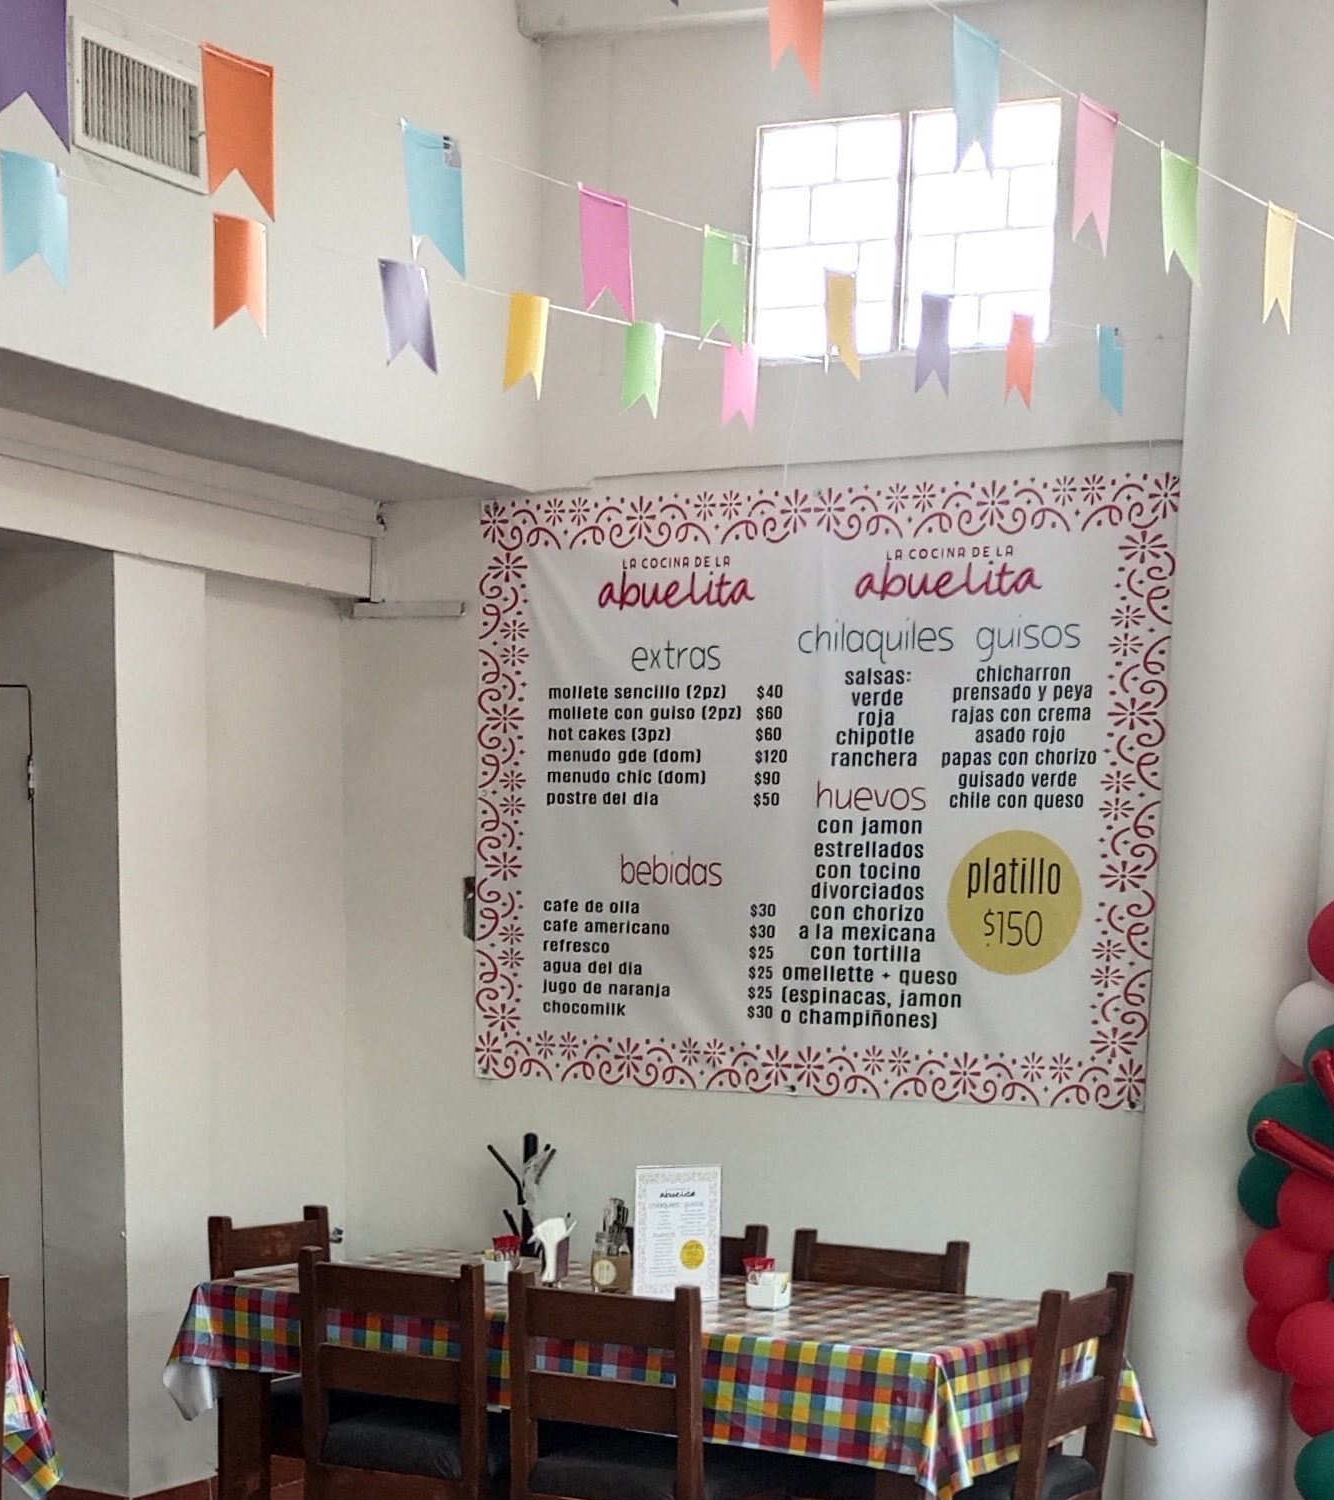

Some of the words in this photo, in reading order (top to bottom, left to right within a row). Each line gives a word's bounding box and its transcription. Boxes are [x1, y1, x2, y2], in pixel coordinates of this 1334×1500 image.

[886, 549, 902, 561] LA
[909, 547, 966, 560] COCINA
[972, 546, 991, 558] DE
[996, 545, 1014, 557] LA
[622, 558, 636, 570] LA
[641, 557, 690, 569] COCINA
[695, 556, 711, 568] DE
[716, 556, 730, 567] LA
[854, 559, 1043, 601] abuelita
[598, 571, 755, 611] abuelita
[798, 617, 954, 664] chilaquiles
[976, 614, 1081, 663] guisos
[632, 640, 721, 672] extras
[844, 668, 912, 686] salsas:
[976, 665, 1071, 682] chicharron
[548, 685, 608, 699] mollete
[614, 685, 680, 699] sencillo
[686, 684, 727, 701] (2pz)
[756, 684, 783, 701] $40
[851, 689, 903, 707] verde
[953, 684, 1031, 703] prensado
[1038, 685, 1047, 702] y
[1053, 684, 1093, 702] peya
[548, 706, 608, 720] mollete
[614, 707, 643, 720] con
[650, 706, 695, 722] guiso
[701, 706, 742, 722] (2pz)
[756, 705, 783, 722] $60
[857, 708, 895, 728] roja
[951, 707, 994, 724] rajas
[1000, 705, 1031, 722] con
[1038, 705, 1091, 722] crema
[548, 728, 573, 741] hot
[578, 728, 626, 741] cakes
[631, 727, 671, 743] (3pz)
[755, 727, 782, 743] $60
[835, 727, 915, 748] chipotle
[975, 727, 1025, 744] asado
[1032, 726, 1065, 745] rojo
[547, 749, 611, 762] menudo
[617, 749, 647, 764] gde
[653, 748, 701, 764] (dom)
[754, 749, 788, 765] $120
[830, 749, 917, 767] ranchera
[941, 750, 992, 768] papas
[998, 750, 1028, 766] con
[1035, 748, 1097, 766] chorizo
[547, 770, 610, 784] menudo
[617, 770, 652, 784] chic
[657, 770, 706, 786] (dom)
[754, 771, 781, 787] $90
[958, 770, 1025, 789] guisado
[1031, 770, 1077, 788] verde
[546, 792, 597, 807] postre
[602, 792, 626, 806] del
[753, 792, 780, 808] $50
[816, 780, 926, 812] huevos
[949, 792, 991, 809] chile
[997, 792, 1027, 809] con
[1034, 792, 1084, 810] queso
[817, 818, 853, 835] con
[861, 817, 923, 836] jamon
[814, 841, 924, 859] estrellados
[621, 852, 723, 887] bebidas
[815, 863, 852, 880] con
[859, 861, 921, 880] tocino
[967, 857, 1061, 899] platillo
[811, 881, 924, 901] divorciados
[543, 899, 579, 913] cafe
[584, 899, 604, 914] de
[609, 900, 640, 914] olla
[750, 903, 776, 918] $30
[810, 905, 845, 922] con
[853, 904, 924, 923] chorizo
[543, 919, 578, 933] cafe
[584, 920, 670, 935] americano
[749, 924, 776, 939] $30
[799, 925, 809, 941] a
[815, 924, 833, 941] la
[841, 924, 936, 943] mexicana
[984, 908, 1043, 947] $150
[543, 939, 610, 954] refresco
[748, 945, 774, 961] $25
[810, 945, 845, 962] con
[853, 945, 921, 963] tortilla
[543, 960, 581, 974] agua
[587, 960, 612, 975] del
[618, 962, 643, 976] dia
[748, 966, 773, 981] $25
[782, 964, 874, 983] omellette
[898, 970, 957, 986] queso
[542, 979, 577, 995] jugo
[583, 981, 602, 995] de
[608, 982, 671, 998] naranja
[747, 986, 773, 1001] $25
[781, 986, 892, 1008] (espinacas,
[898, 990, 961, 1009] jamon
[542, 1000, 626, 1016] chocomilk
[747, 1005, 773, 1020] $30
[780, 1009, 791, 1024] o
[798, 1008, 938, 1030] champiñones)
